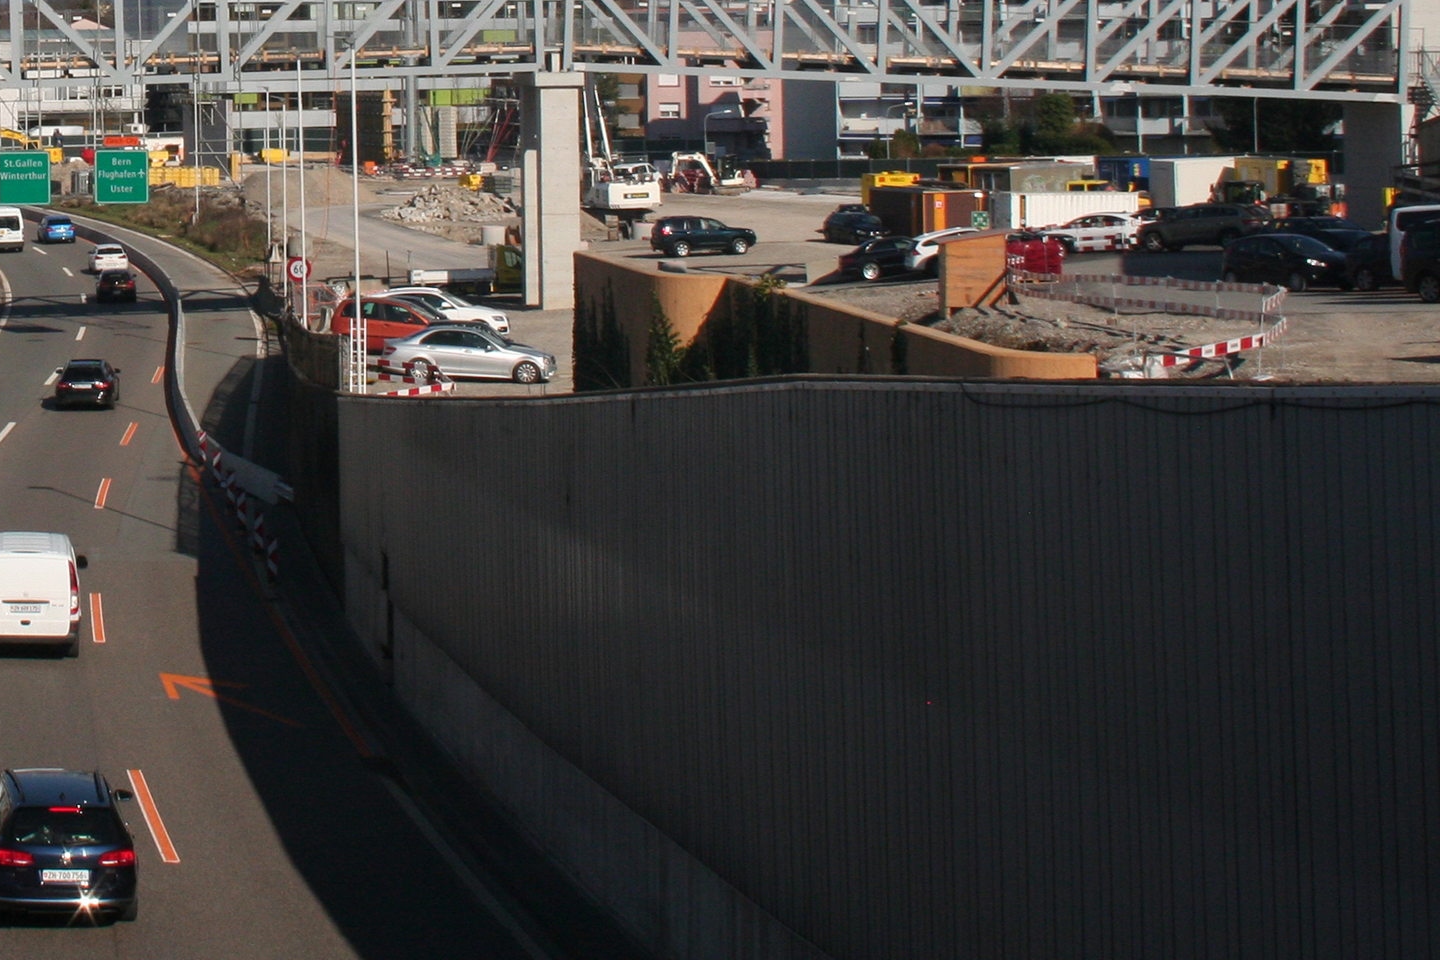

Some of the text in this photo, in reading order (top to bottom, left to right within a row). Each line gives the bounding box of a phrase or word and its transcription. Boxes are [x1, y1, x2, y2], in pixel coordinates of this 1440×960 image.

[3, 159, 43, 168] St.Gallen
[112, 158, 132, 166] Bern
[0, 172, 46, 180] Winterthur
[98, 170, 137, 180] Flughafen
[110, 185, 134, 193] Uster
[294, 265, 304, 274] 60
